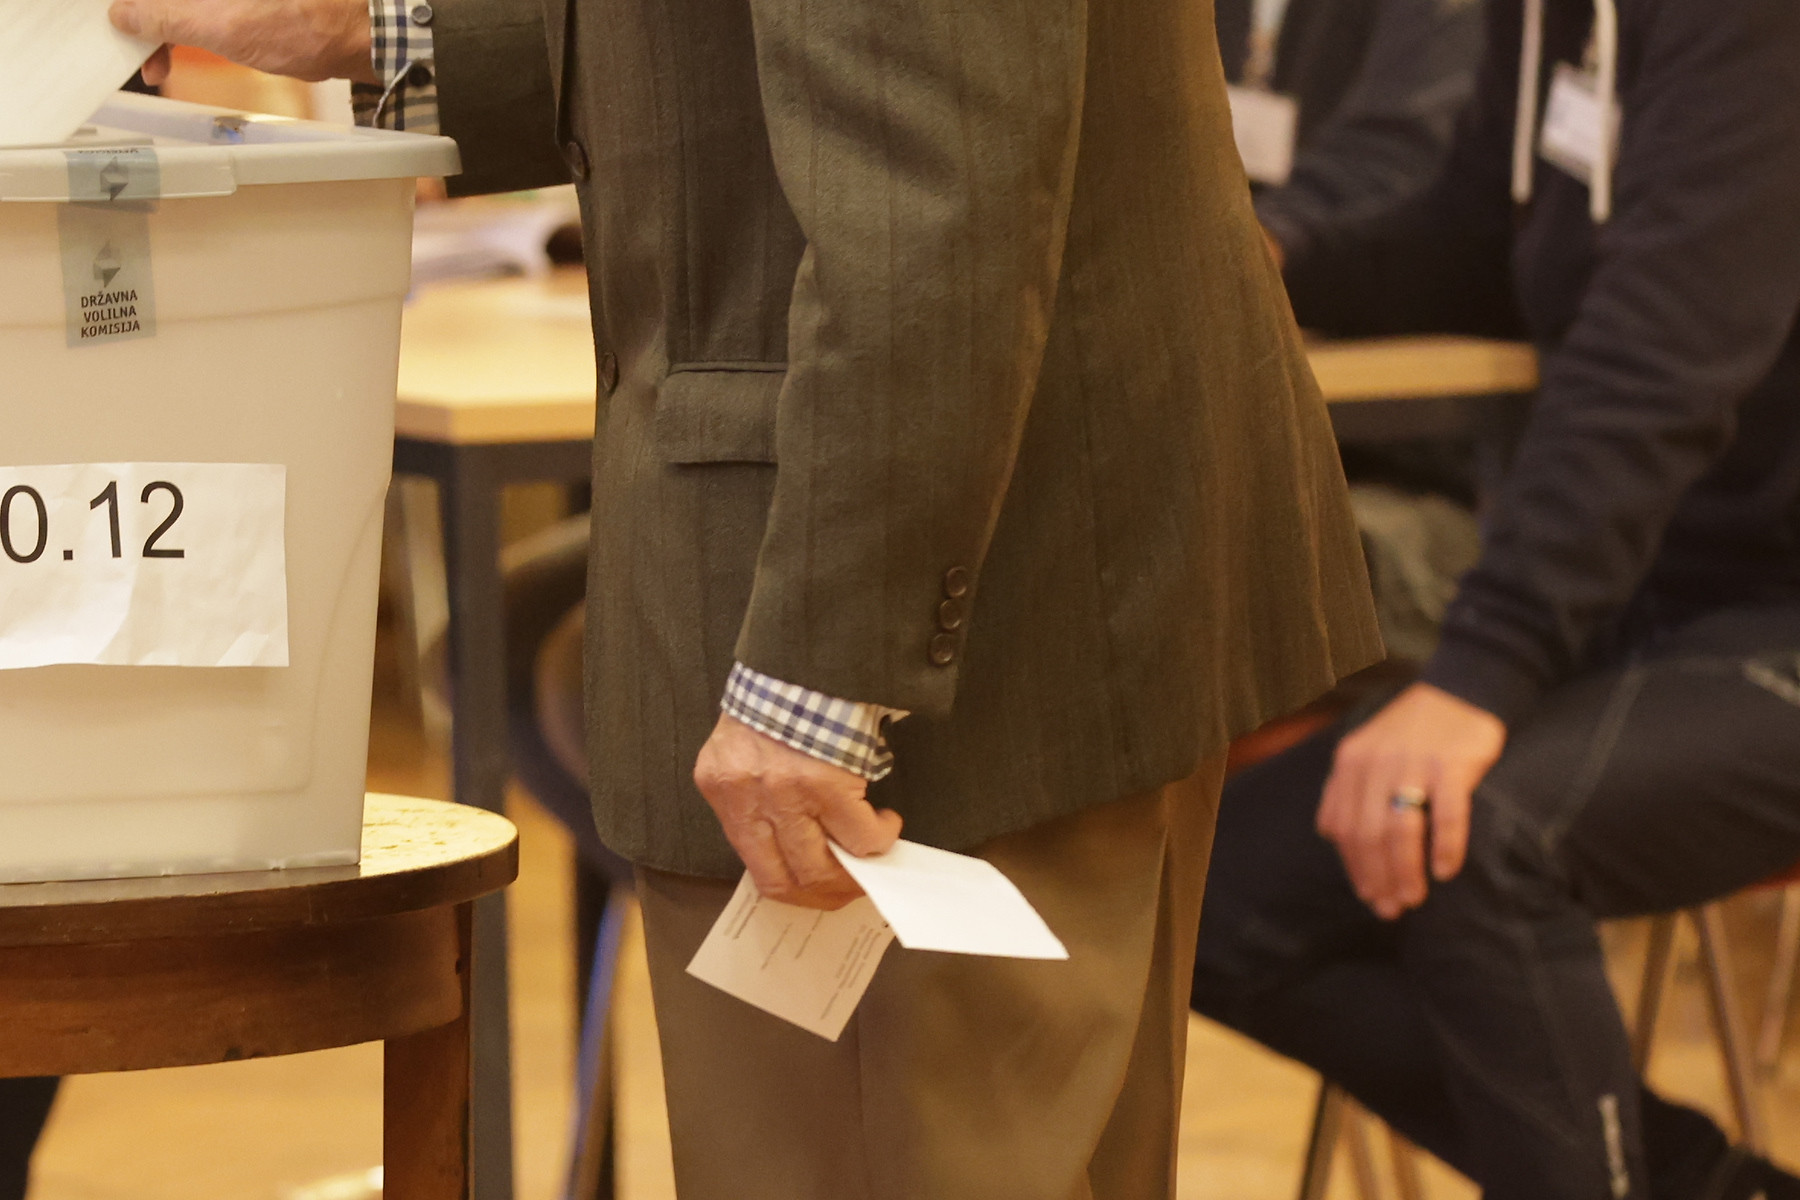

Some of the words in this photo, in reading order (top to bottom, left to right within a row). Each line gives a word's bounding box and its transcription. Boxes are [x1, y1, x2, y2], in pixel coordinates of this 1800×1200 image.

[81, 289, 138, 308] DRŽAVNA
[83, 305, 137, 323] VOLILNA
[81, 320, 141, 338] KOMISIJA
